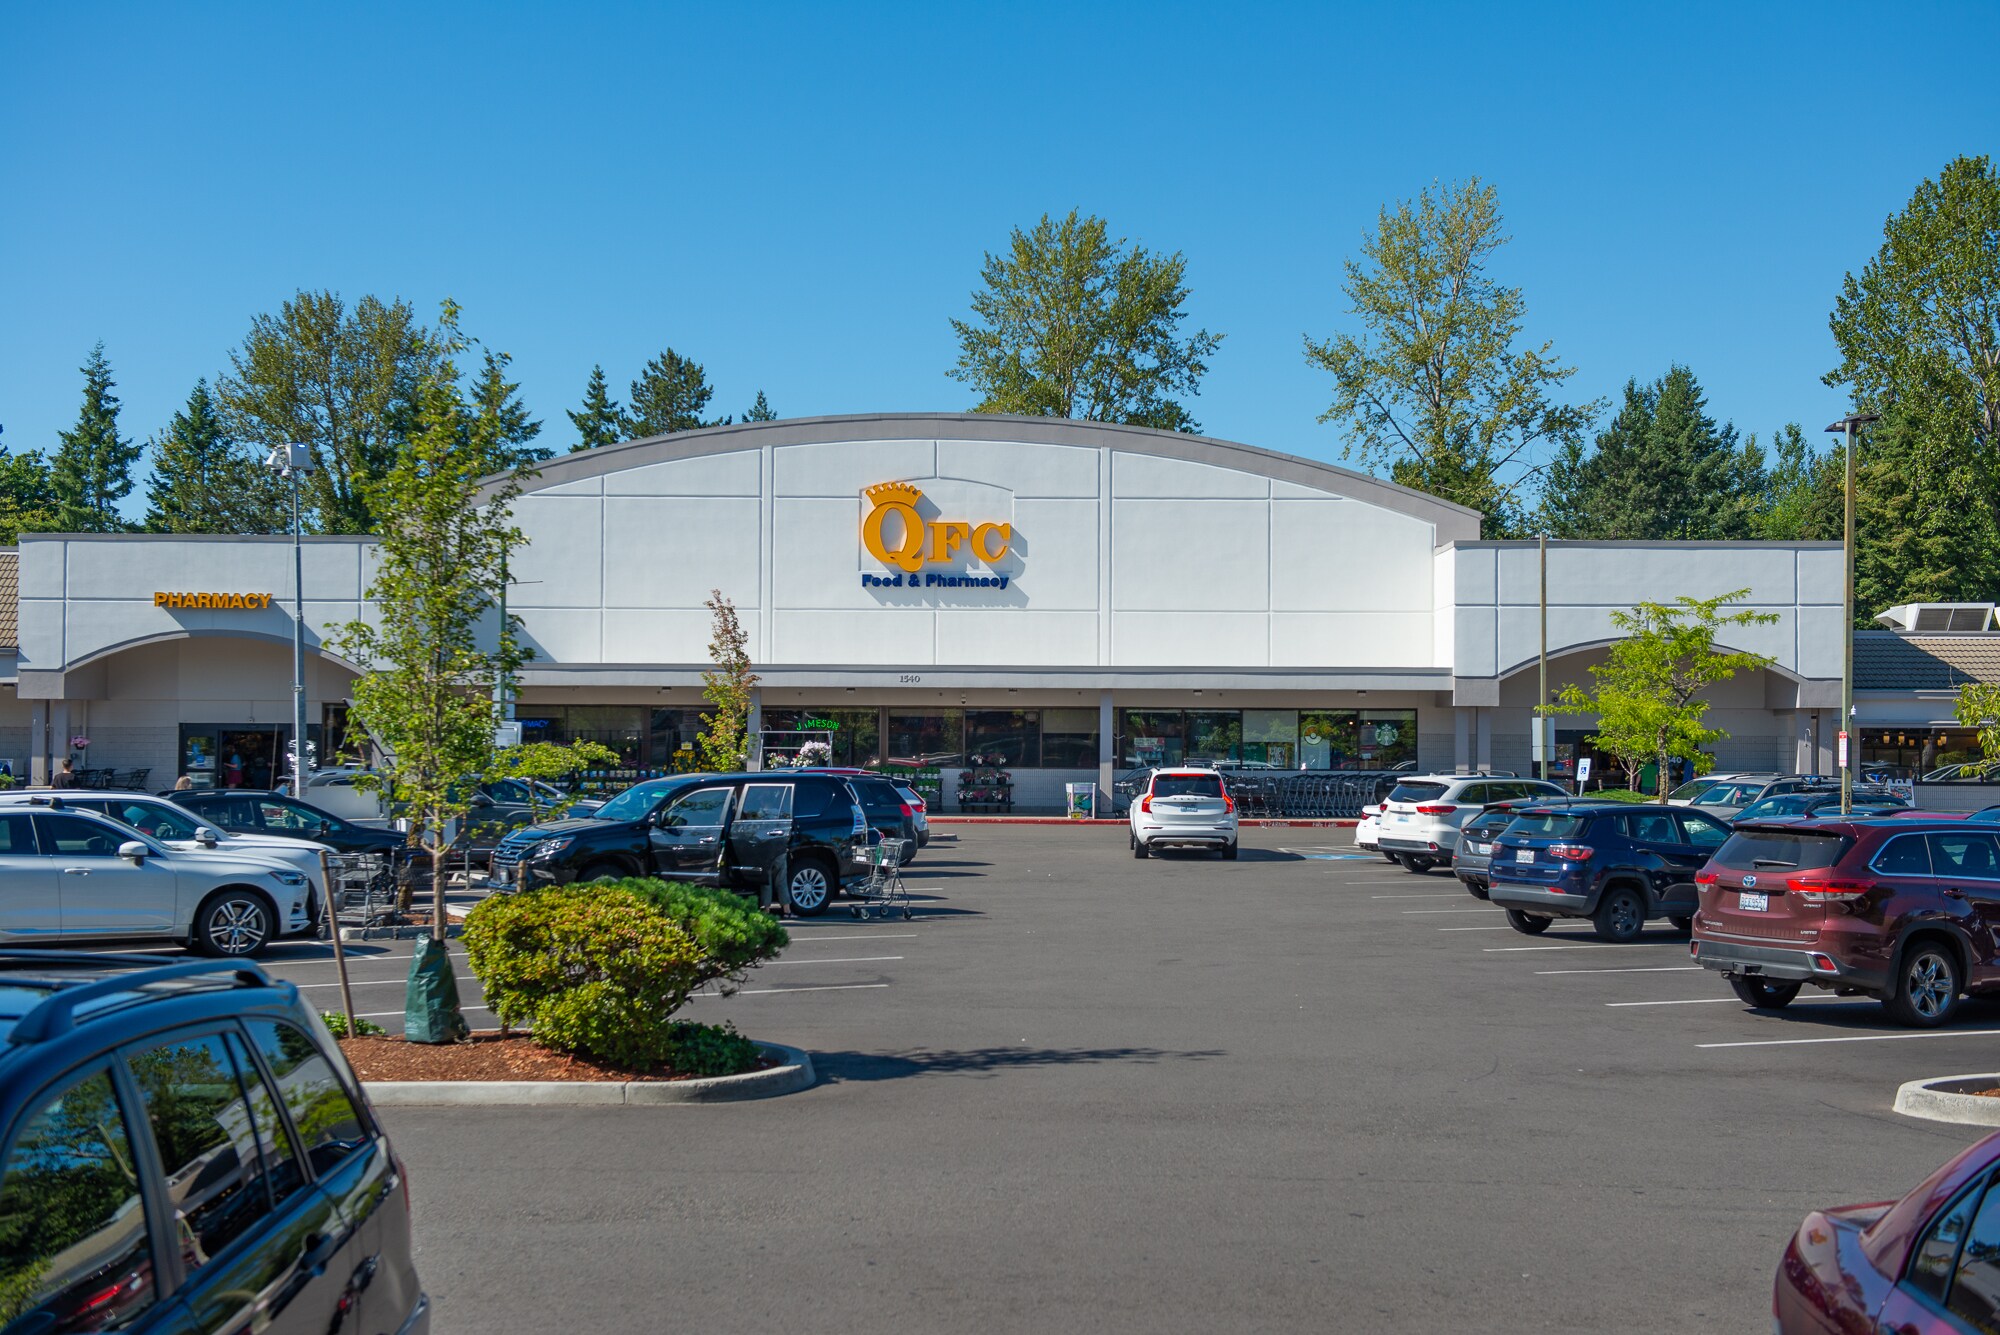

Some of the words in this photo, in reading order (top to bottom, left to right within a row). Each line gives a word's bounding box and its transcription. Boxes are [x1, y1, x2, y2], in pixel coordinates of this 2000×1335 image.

[863, 501, 1011, 573] QFC
[862, 574, 903, 587] Food
[908, 574, 921, 588] &
[926, 574, 1009, 590] Pharmacy
[154, 592, 273, 609] PHARMACY
[899, 675, 921, 683] 1540
